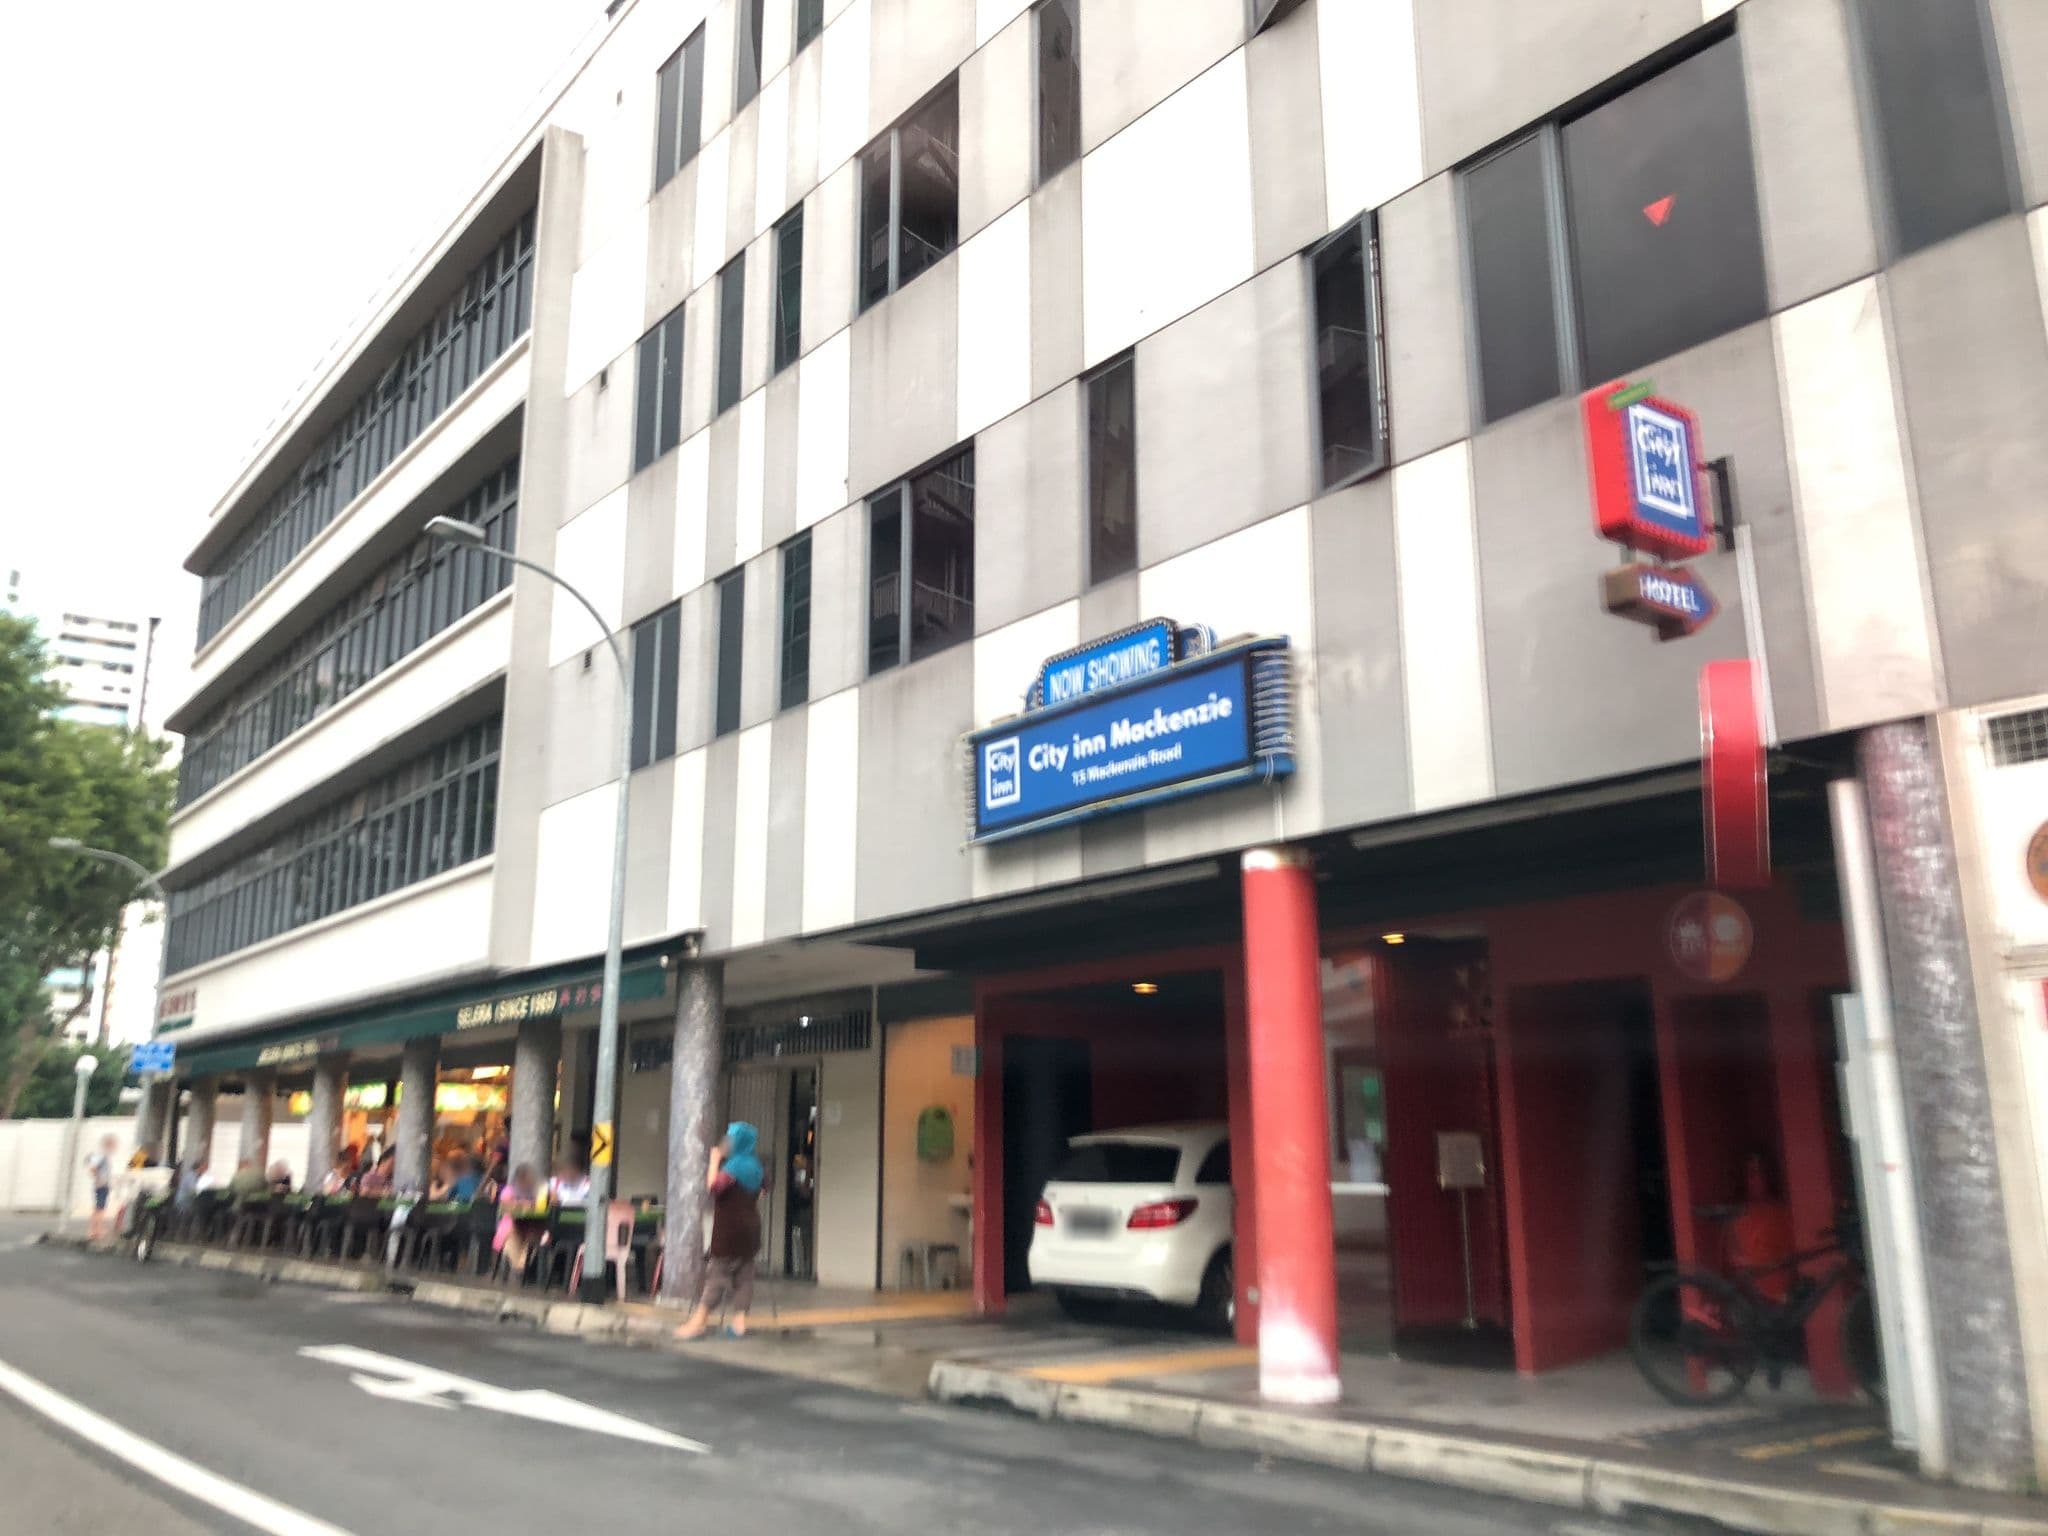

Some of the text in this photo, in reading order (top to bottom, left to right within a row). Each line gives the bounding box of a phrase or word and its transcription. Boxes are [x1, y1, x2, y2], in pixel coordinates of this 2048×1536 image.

[1637, 423, 1680, 467] City
[1640, 576, 1700, 612] HOTEL
[1050, 638, 1160, 702] NOW SHOWING
[1028, 692, 1233, 772] City inn Mackenzie
[991, 752, 1015, 773] City
[1089, 753, 1148, 780] Mackenzie
[1150, 742, 1182, 766] Road
